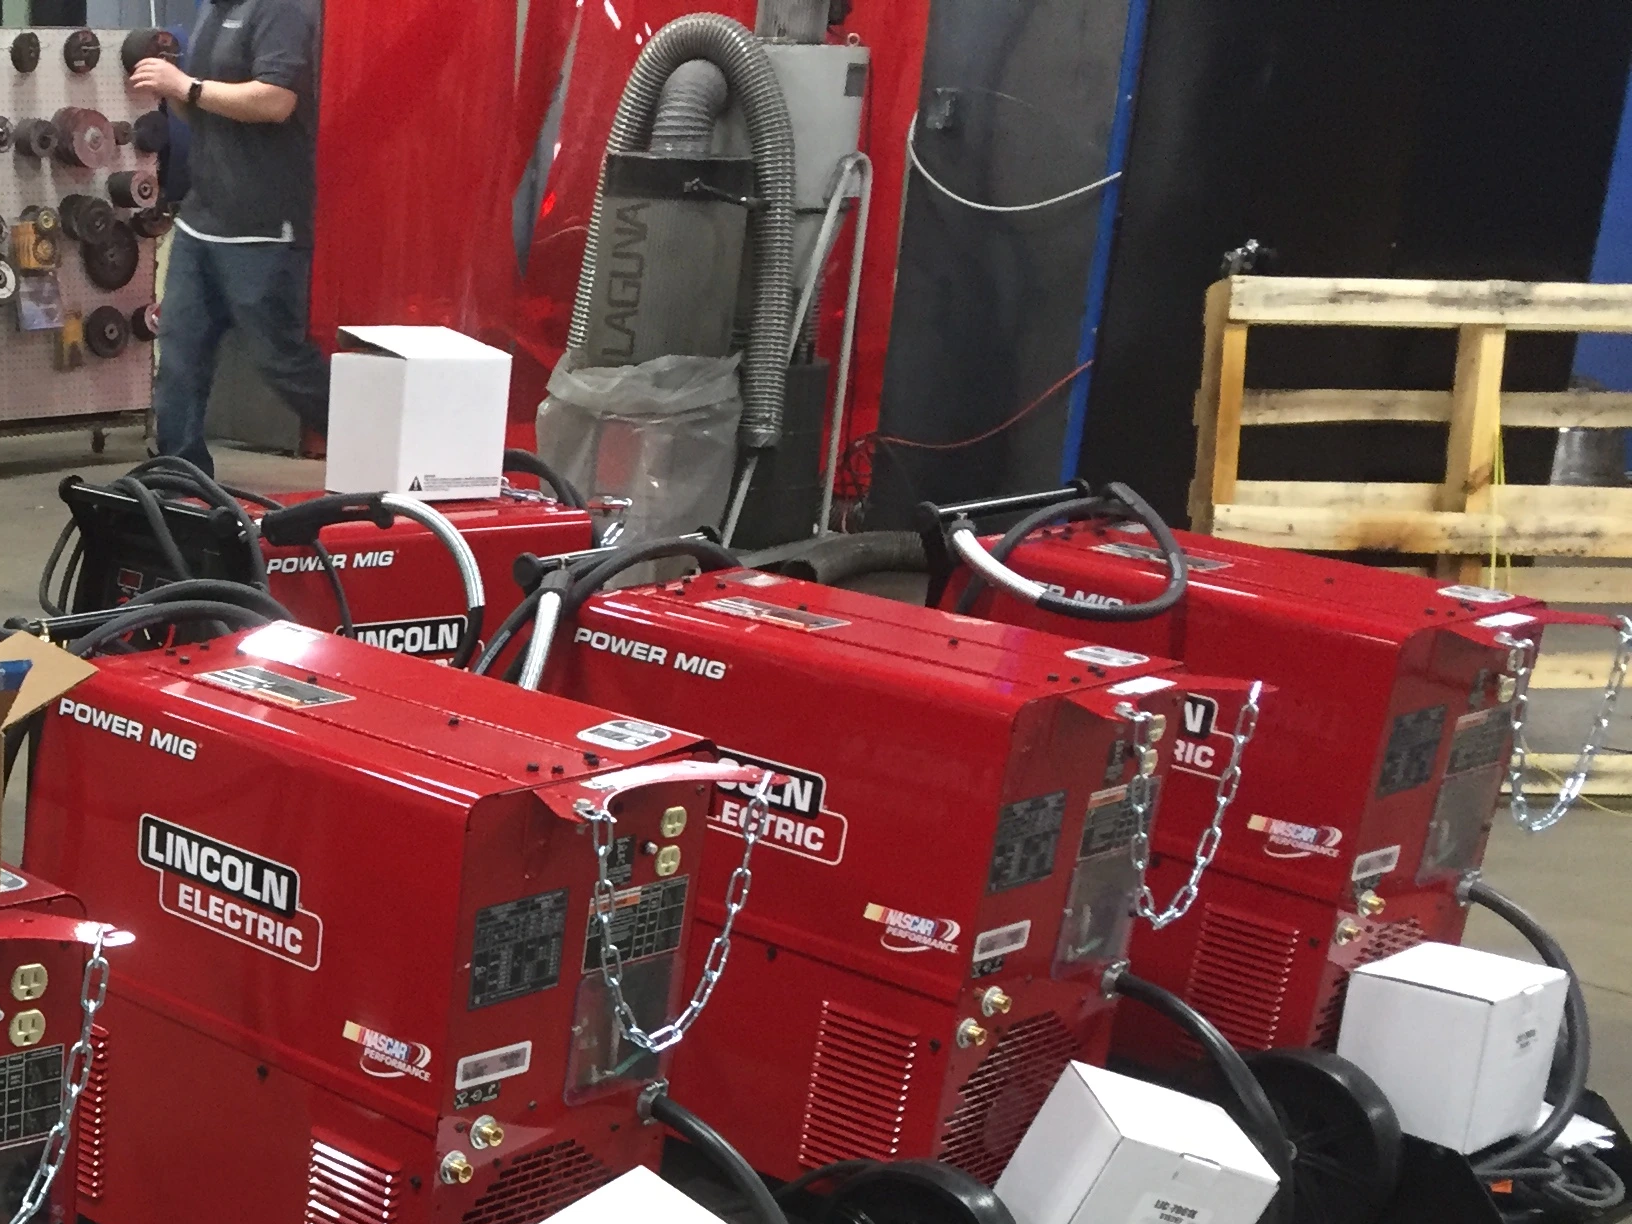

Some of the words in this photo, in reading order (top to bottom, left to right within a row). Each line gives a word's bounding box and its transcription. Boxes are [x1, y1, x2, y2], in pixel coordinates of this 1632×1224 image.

[601, 201, 651, 357] LAGUNA
[353, 550, 395, 569] MIG
[573, 627, 667, 665] POWER
[674, 652, 727, 680] MIG
[59, 698, 143, 742] POWER
[149, 728, 198, 761] MIG
[147, 824, 290, 911] LINCOLN
[177, 882, 304, 955] ELECTRIC
[886, 909, 935, 936] NASCAR
[363, 1028, 409, 1060] NASCAR
[363, 1047, 431, 1082] PERFORMANCE
